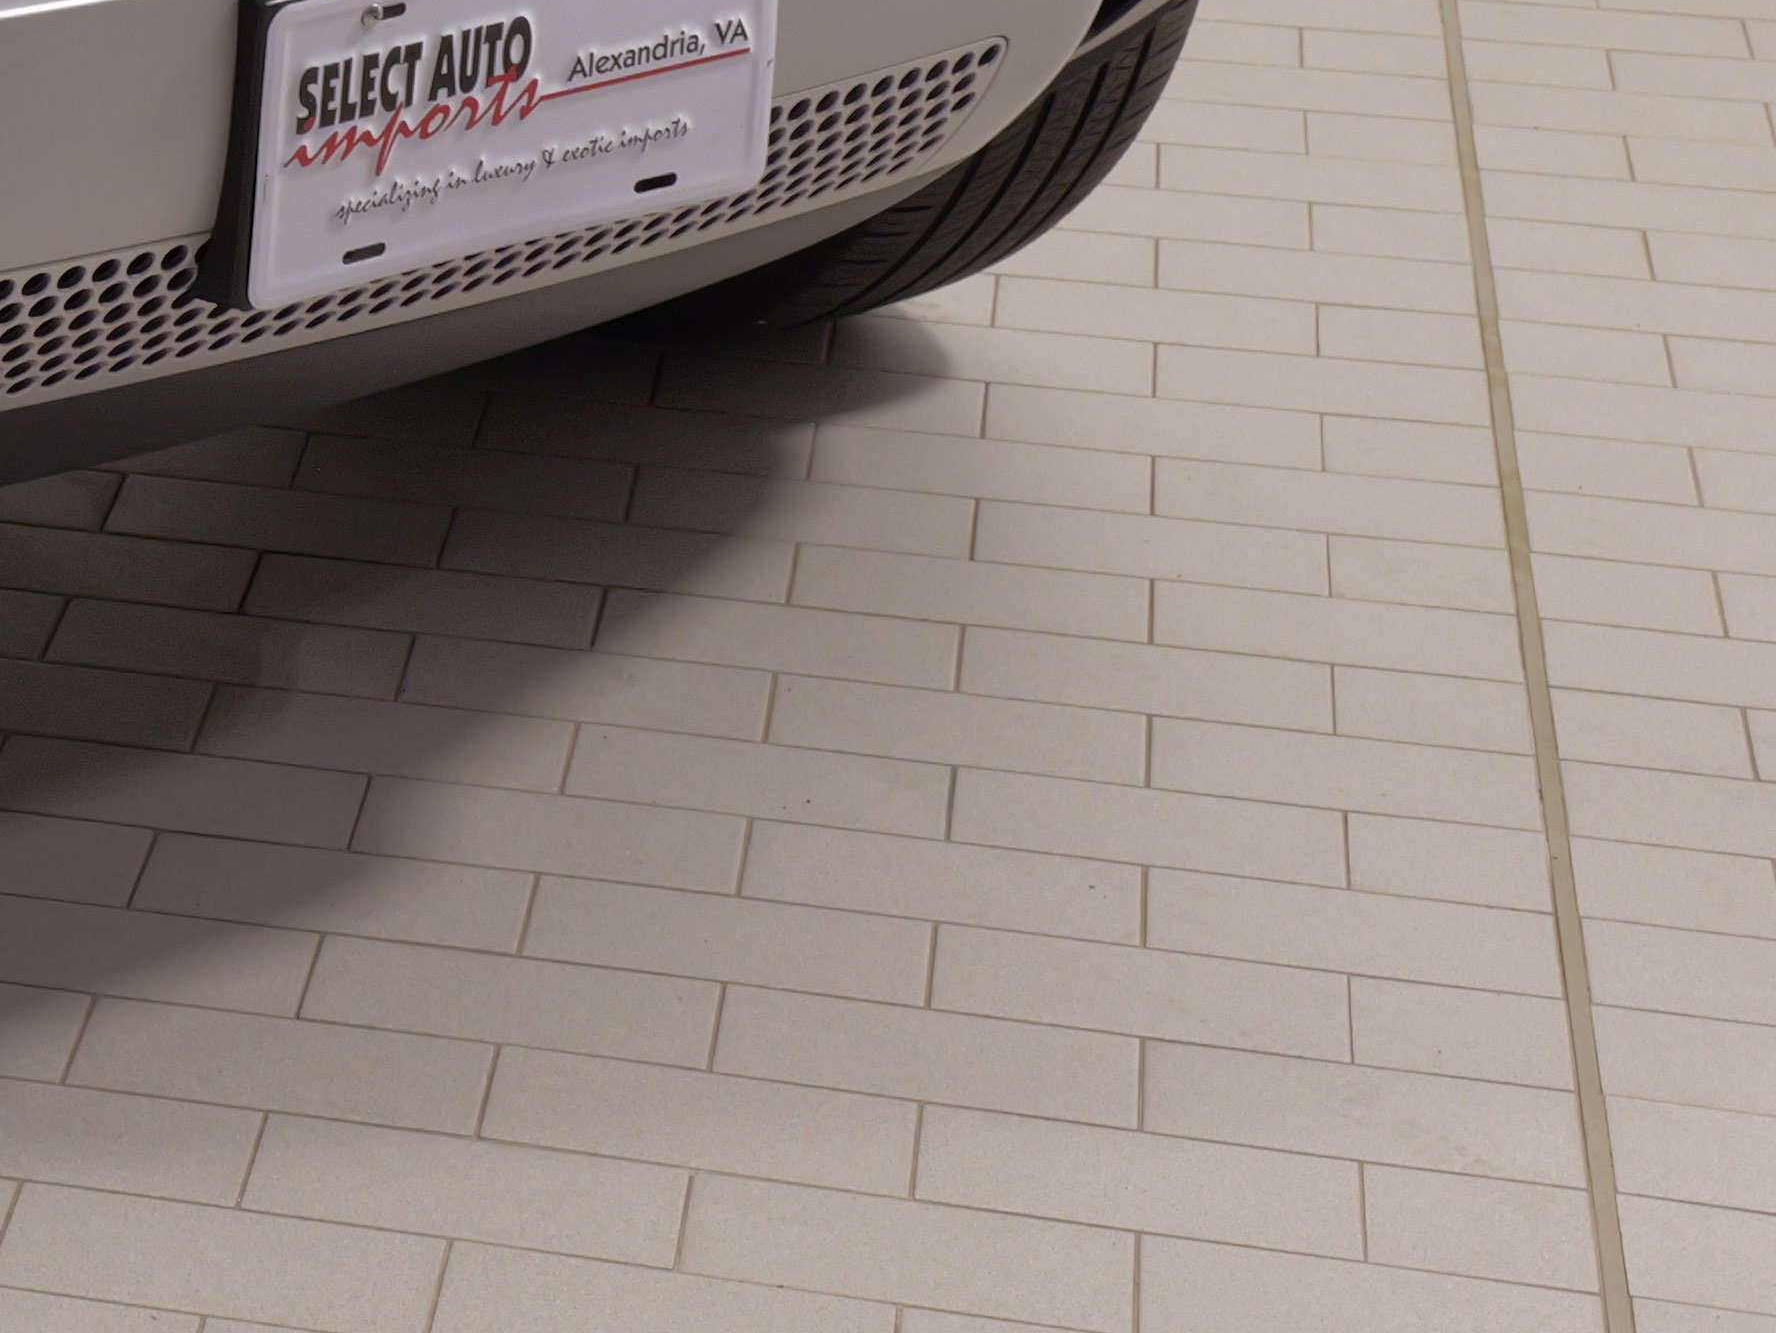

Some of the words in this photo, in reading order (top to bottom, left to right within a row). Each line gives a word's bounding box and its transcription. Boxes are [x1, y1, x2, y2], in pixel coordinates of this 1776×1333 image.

[296, 40, 424, 135] SELECT
[429, 15, 532, 102] AUTO
[567, 27, 706, 82] Alexandria,
[714, 17, 750, 46] VA
[284, 63, 546, 177] imports
[335, 178, 441, 226] specializing
[444, 170, 468, 191] in
[467, 157, 538, 186] luxury
[541, 148, 557, 170] &
[560, 136, 615, 164] exotic
[618, 116, 689, 154] imports
